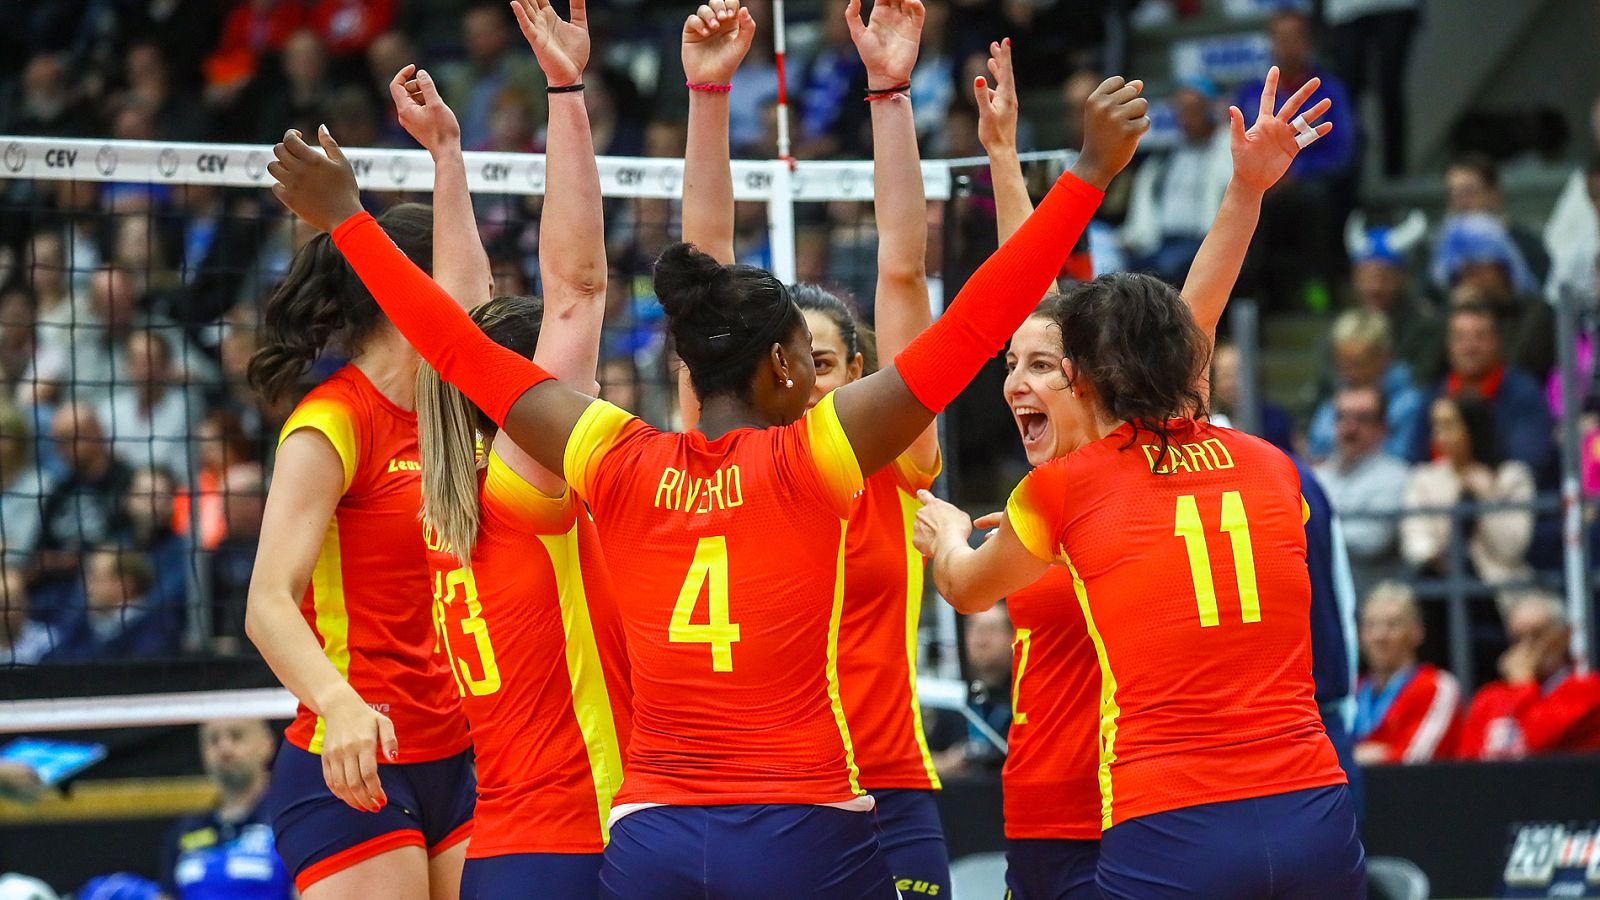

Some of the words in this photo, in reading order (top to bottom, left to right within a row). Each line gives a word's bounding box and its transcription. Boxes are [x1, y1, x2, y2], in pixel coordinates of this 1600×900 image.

[45, 149, 79, 168] CEV
[196, 154, 228, 173] CEV
[350, 158, 373, 178] EV
[482, 162, 512, 181] CEV
[615, 167, 645, 186] CEV
[1141, 438, 1235, 475] CARO
[654, 464, 744, 514] RIVERO
[1174, 490, 1262, 628] 11
[668, 535, 741, 673] 4
[896, 878, 941, 896] eus
